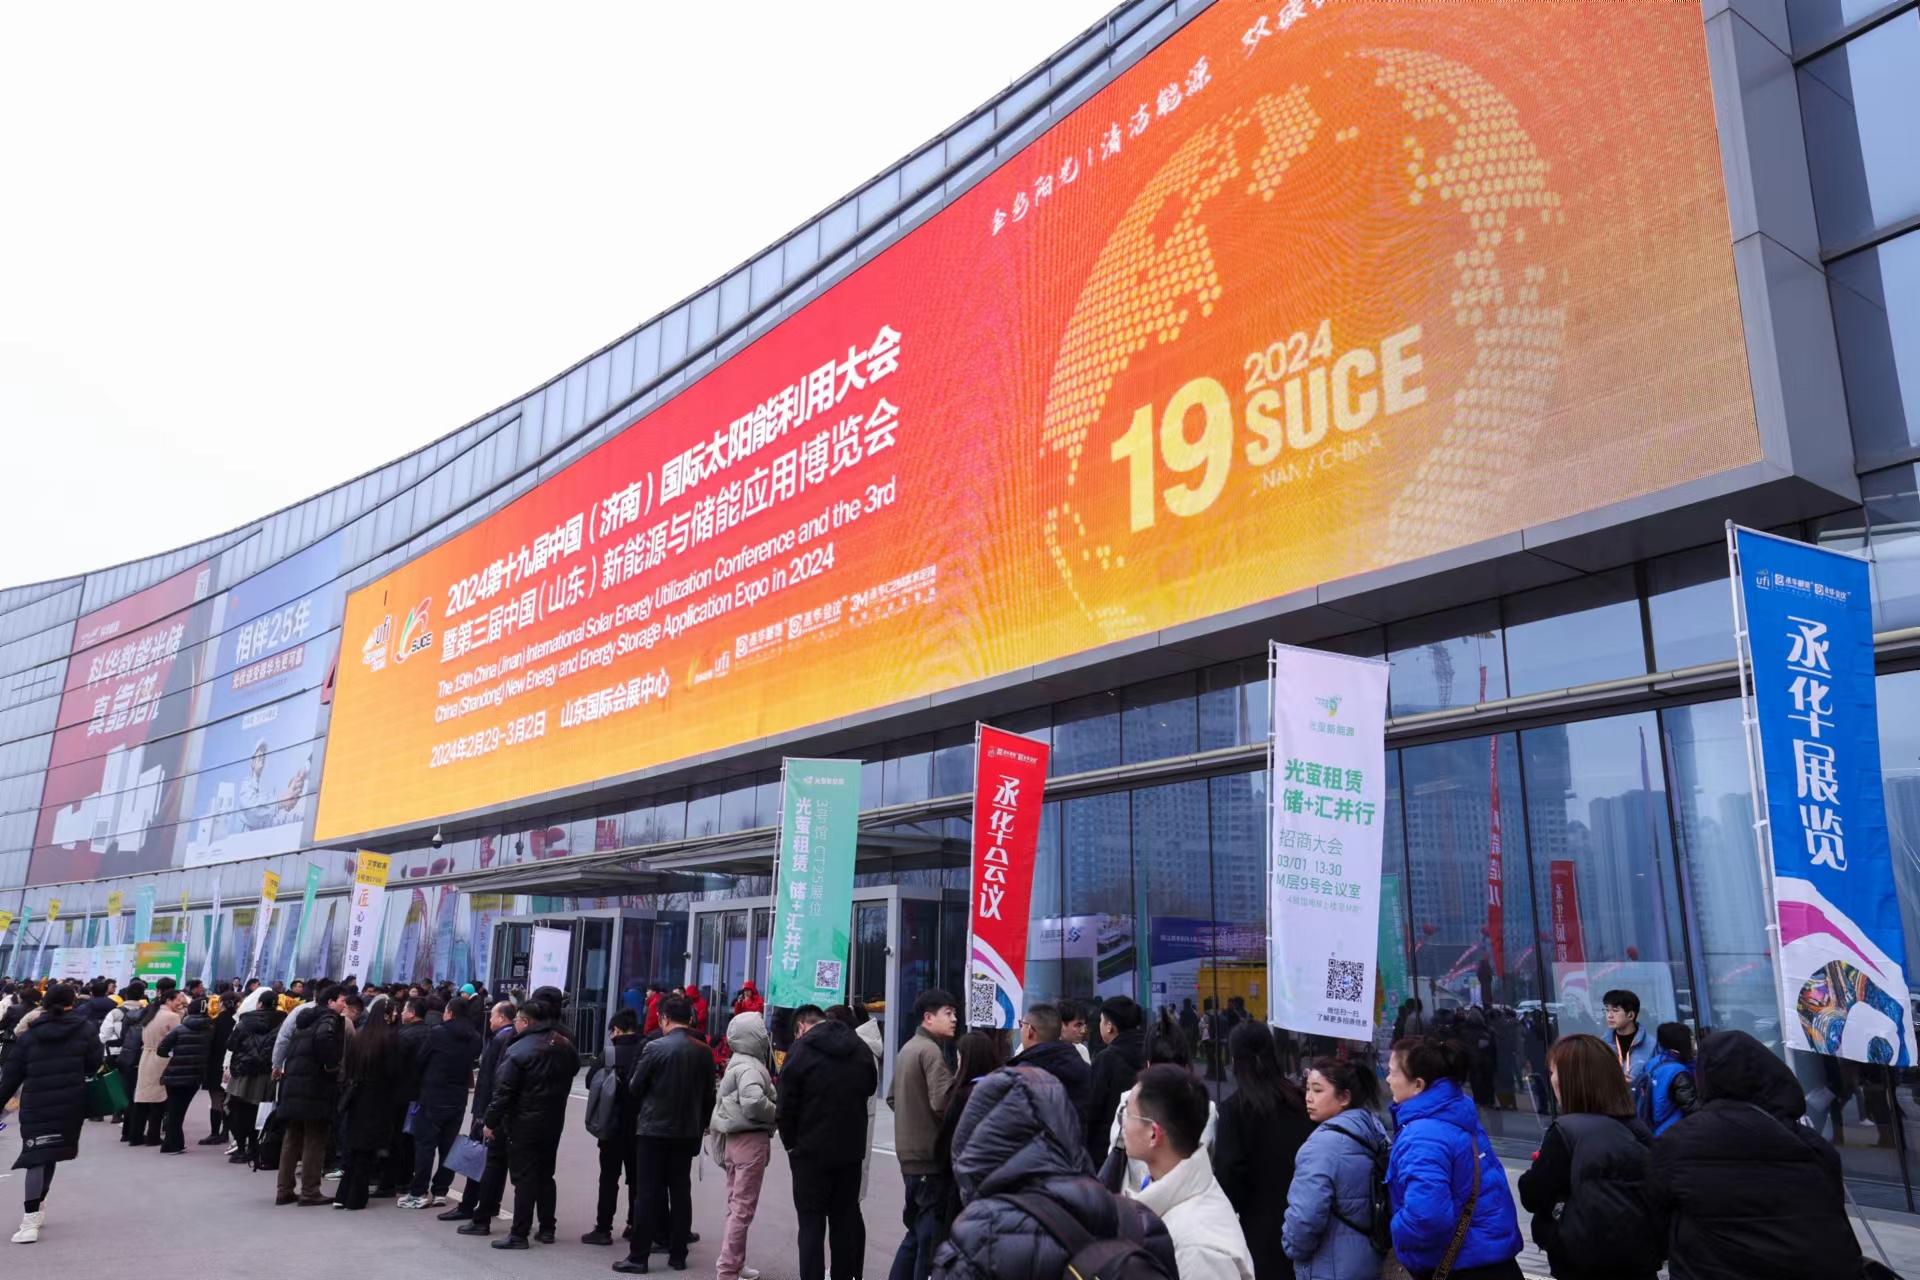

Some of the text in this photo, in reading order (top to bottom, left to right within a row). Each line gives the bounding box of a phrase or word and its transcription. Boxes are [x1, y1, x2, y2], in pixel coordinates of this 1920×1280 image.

[1241, 0, 1326, 60] 双碳
[1244, 318, 1332, 393] 2024
[1245, 324, 1427, 466] SUCE
[1110, 377, 1234, 534] 19
[438, 475, 896, 698] The 19th China (Jinan) International Solar Energy Utilization Conference and the 3rd
[1756, 575, 1770, 587] ufi
[236, 599, 312, 665] 相伴25年
[411, 632, 432, 653] SUCE
[435, 542, 835, 723] China (Shandong) New Energy and Energy Storage Application Expo in 2024
[560, 666, 670, 728] 山东国际会展中心
[1787, 615, 1847, 872] 丞华展览
[1283, 788, 1375, 825] 储+汇并行
[1284, 759, 1363, 794] 光萤租赁
[979, 774, 1020, 920] 丞华会议
[1277, 854, 1342, 876] 03/01 13:30
[1279, 828, 1343, 856] 招商大会
[782, 797, 812, 971] 光萤租赁 储+汇并行
[1276, 873, 1361, 900] M层9号会议室
[1317, 1014, 1367, 1027] 了解更多招商信息
[1327, 1007, 1359, 1017] 微信扫一扫
